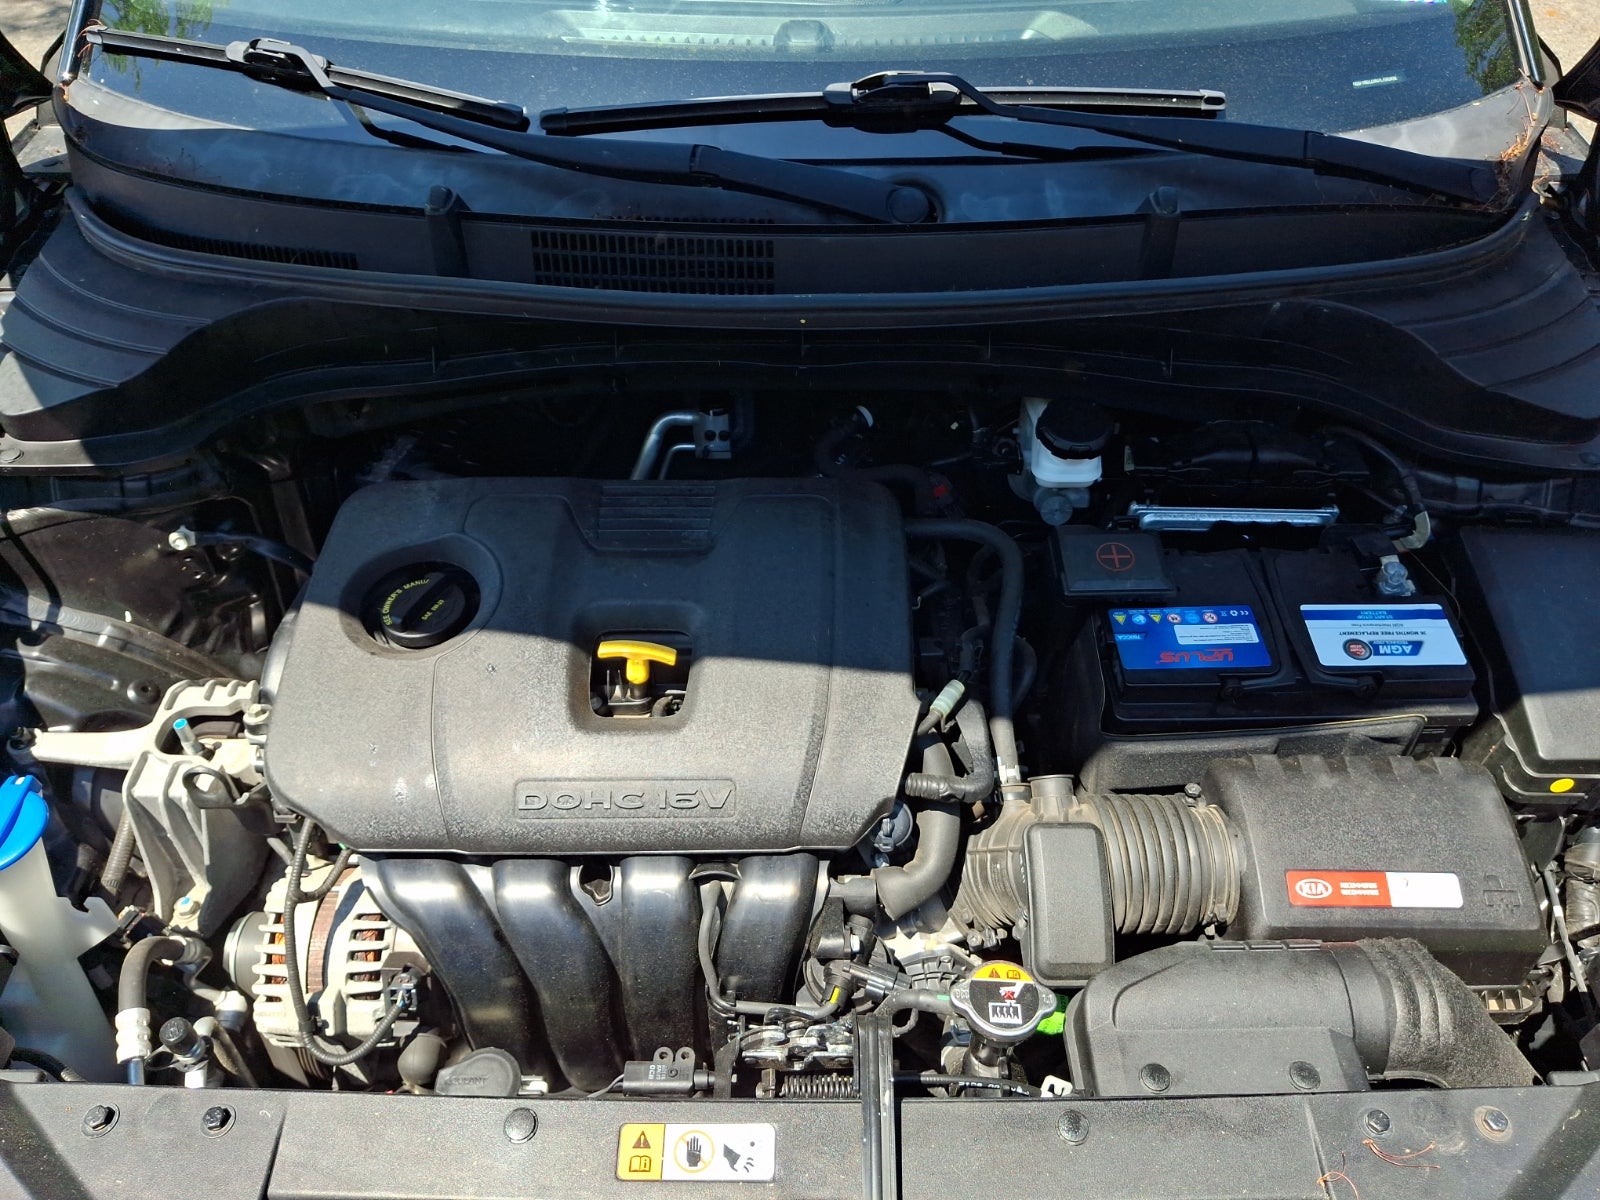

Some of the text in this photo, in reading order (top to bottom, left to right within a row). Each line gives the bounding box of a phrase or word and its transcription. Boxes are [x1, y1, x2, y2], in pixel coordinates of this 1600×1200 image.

[403, 578, 431, 589] MANU
[1379, 644, 1413, 654] AGM
[517, 788, 733, 811] DOHC 16V
[1298, 880, 1330, 897] KIA
